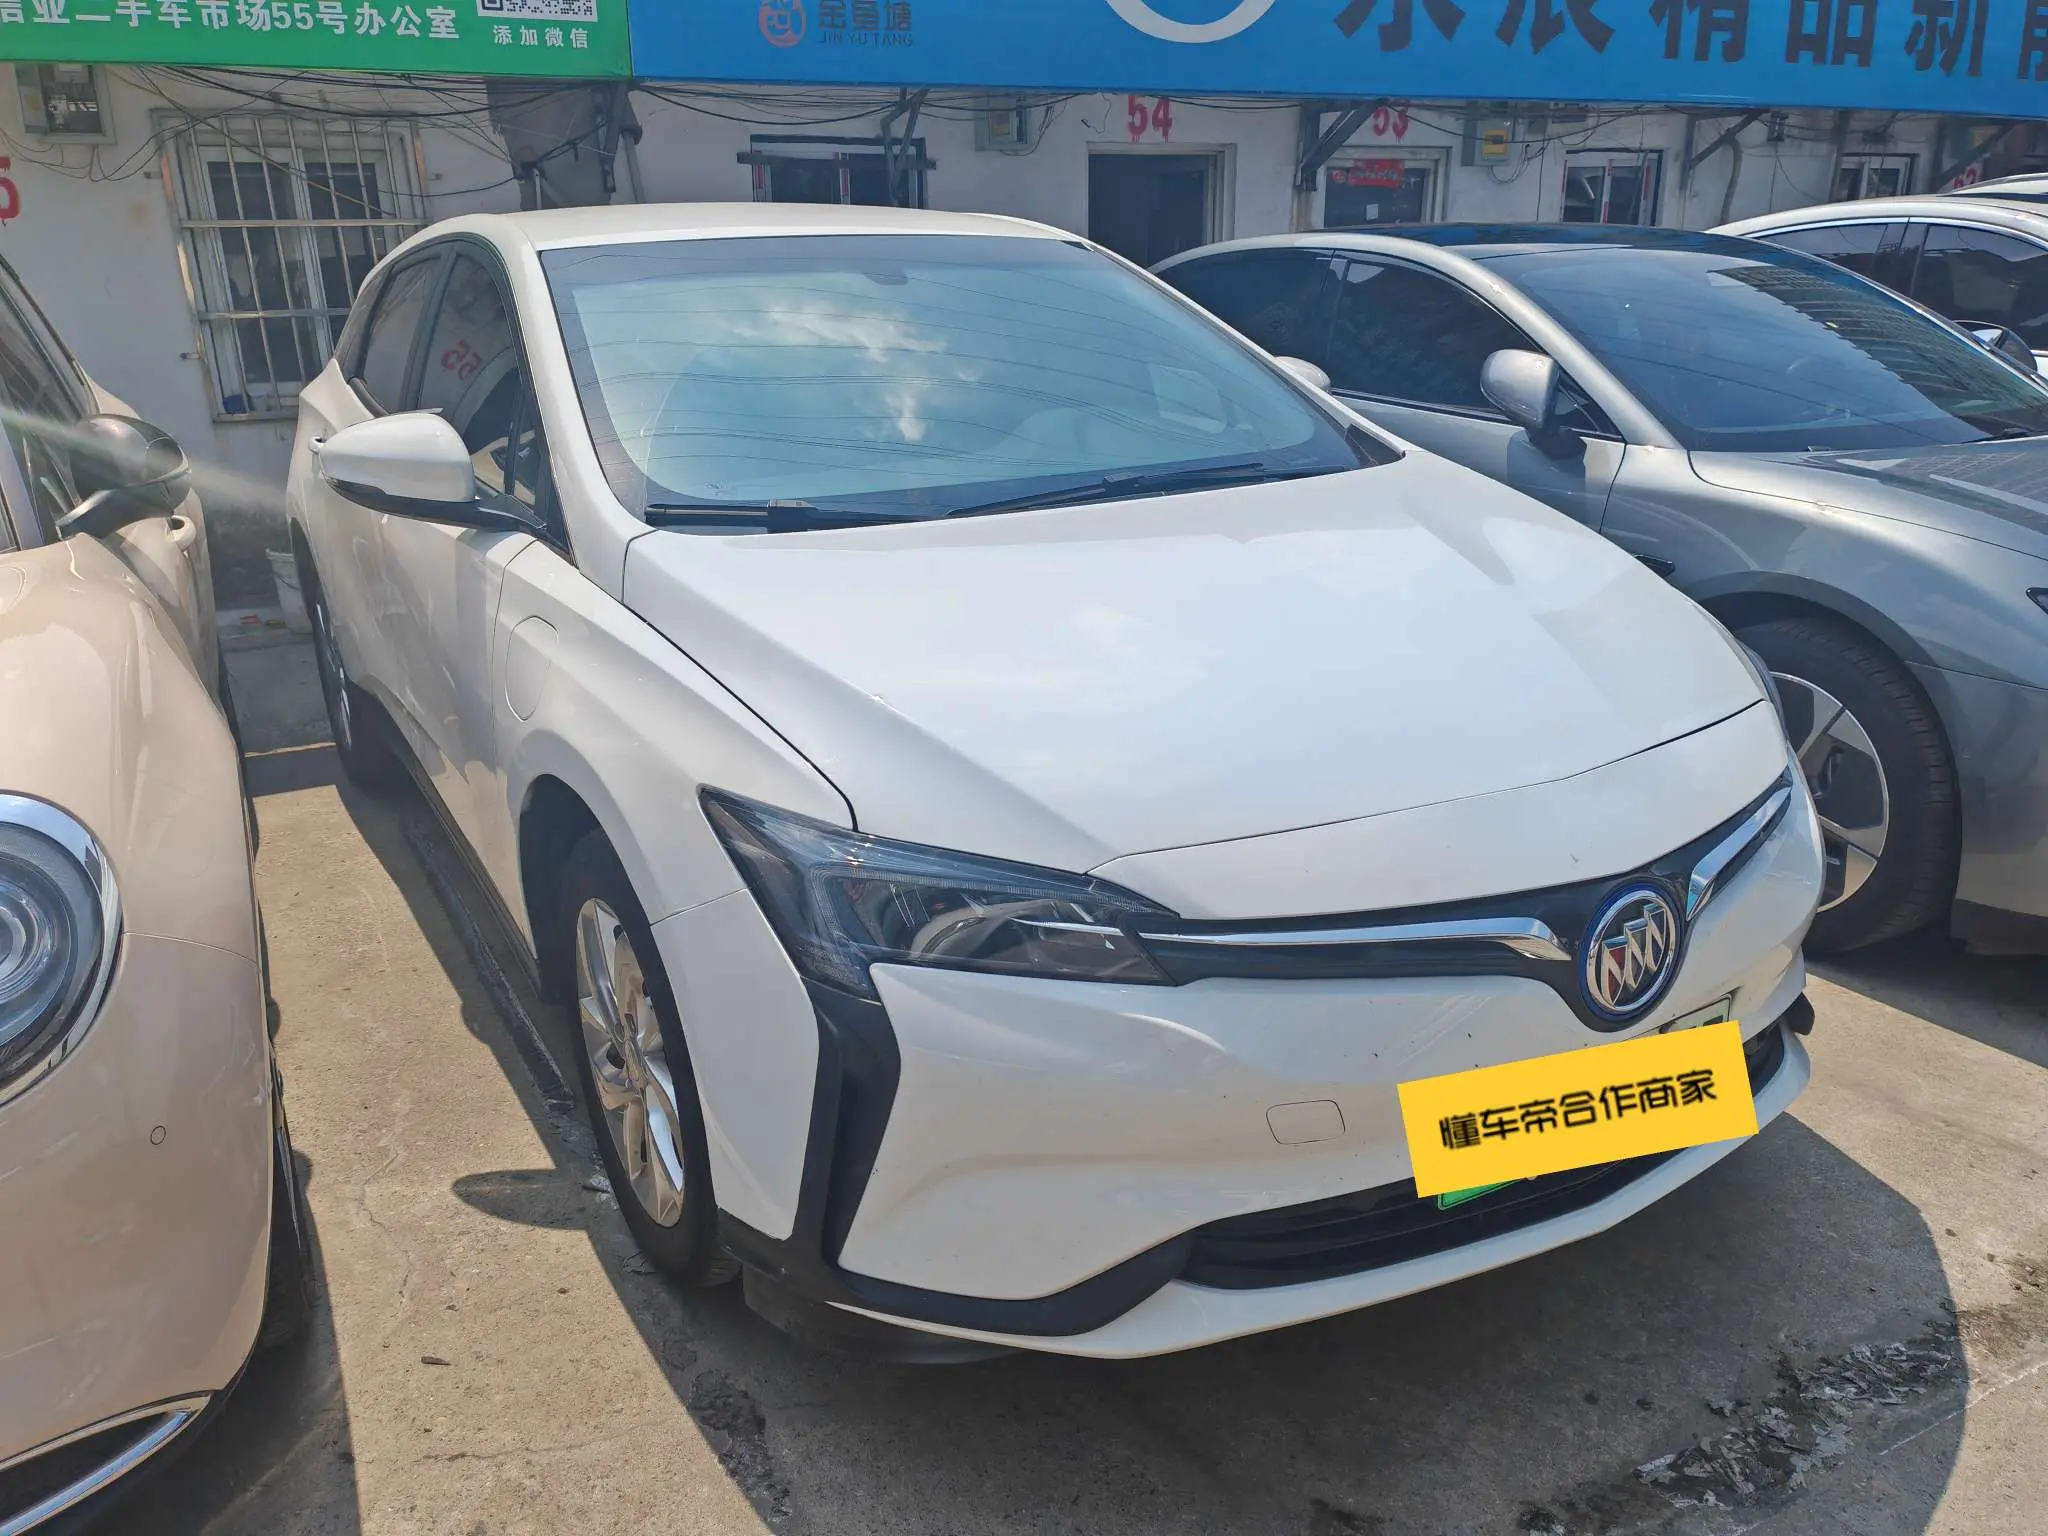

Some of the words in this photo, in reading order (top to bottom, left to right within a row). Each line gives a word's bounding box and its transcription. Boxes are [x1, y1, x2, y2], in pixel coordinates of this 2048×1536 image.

[493, 25, 589, 48] 添加微信
[1127, 94, 1173, 139] 54
